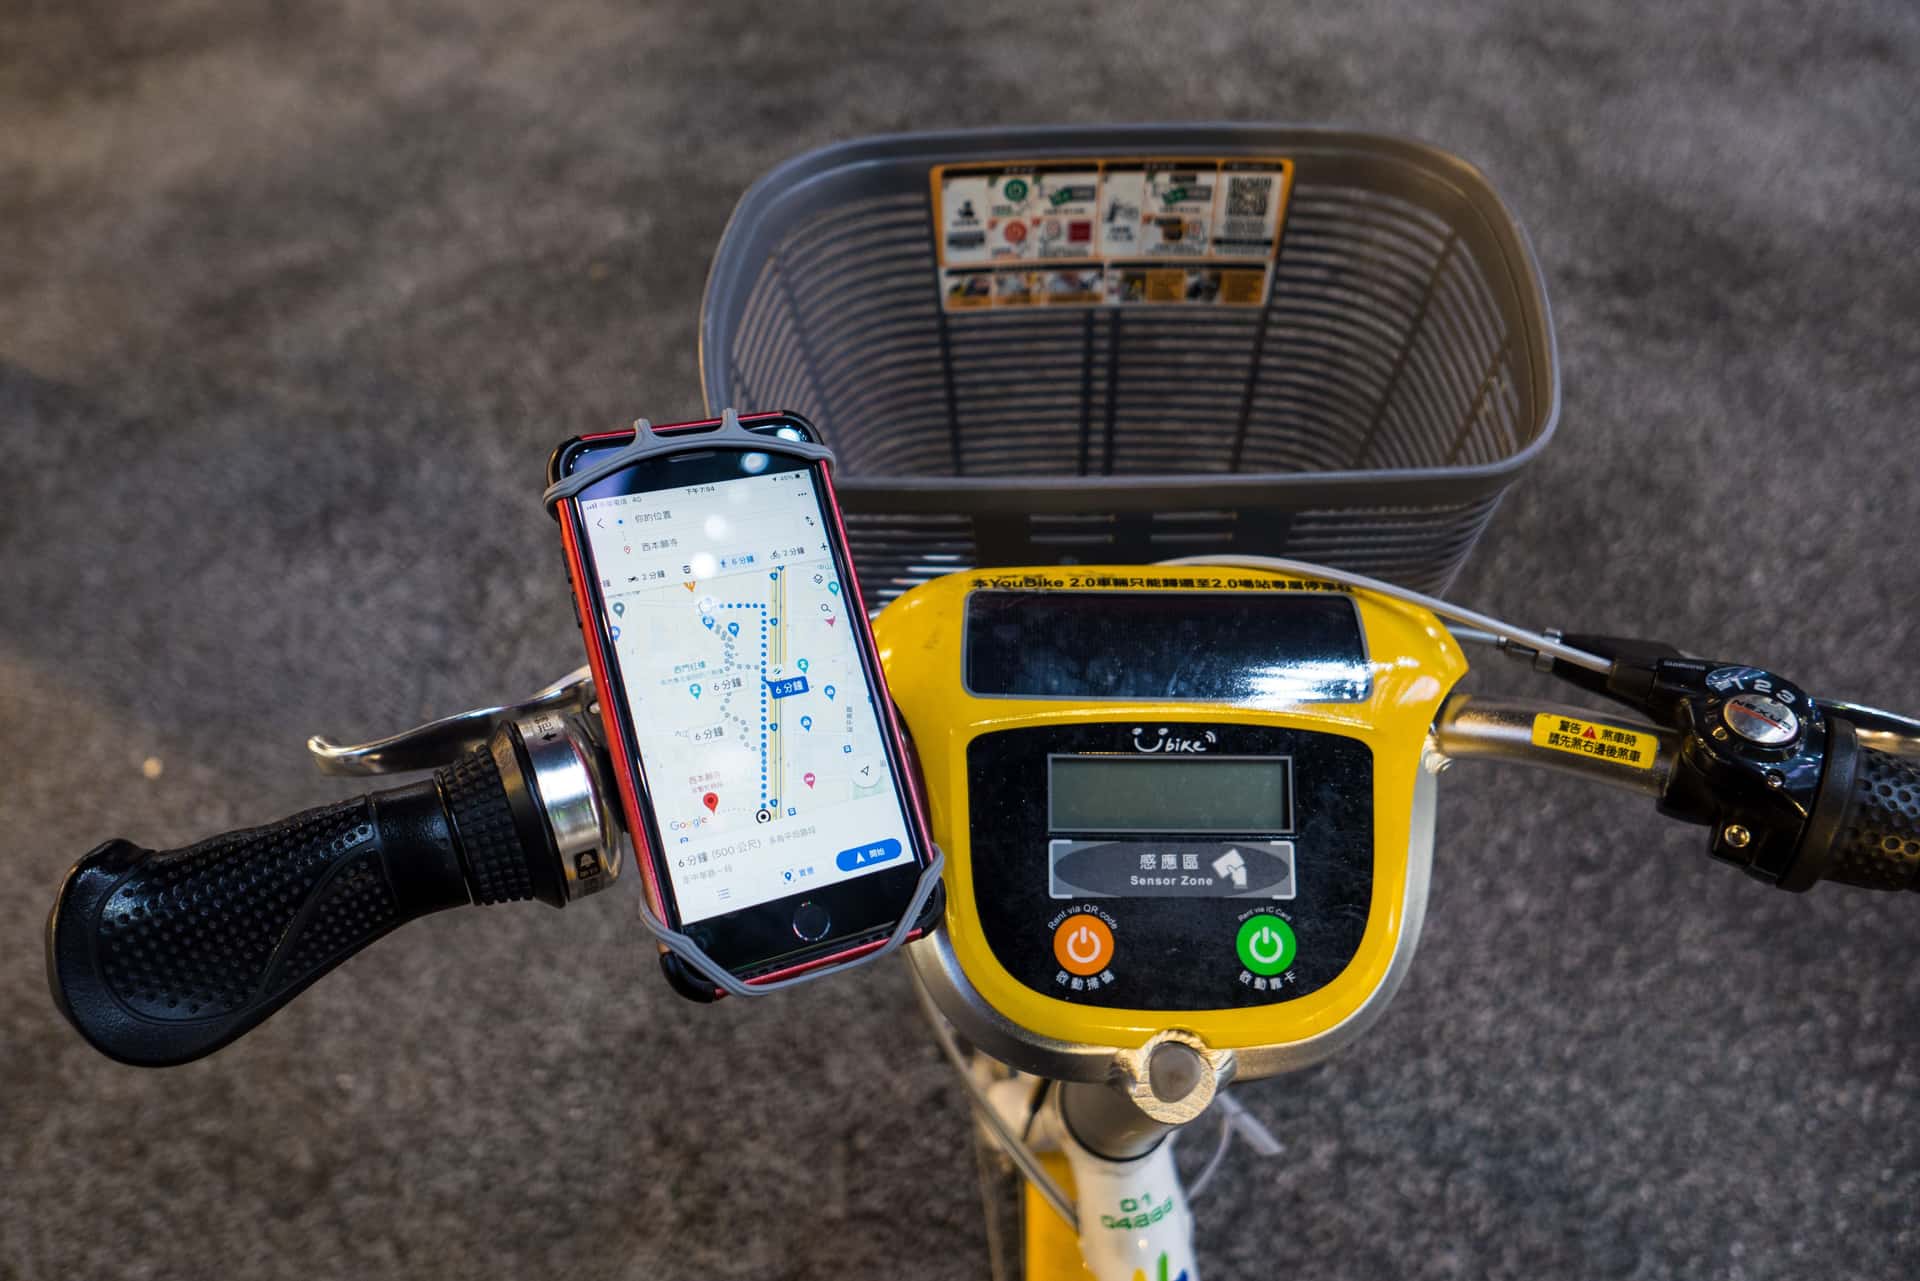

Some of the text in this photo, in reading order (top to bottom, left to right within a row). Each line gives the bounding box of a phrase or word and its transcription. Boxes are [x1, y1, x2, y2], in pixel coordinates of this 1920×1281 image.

[634, 509, 672, 523] 你的位置
[713, 677, 743, 692] 6 分鐘
[775, 681, 805, 695] 6 分鐘
[1753, 679, 1773, 693] 2
[1775, 690, 1796, 704] 3
[1732, 698, 1793, 731] NEXUS
[694, 726, 724, 741] 6 分鐘
[1558, 719, 1638, 747] 警告 煞車時
[1547, 731, 1643, 763] 請先煞右邊後煞車
[669, 814, 708, 831] Google
[678, 858, 686, 869] 6
[686, 852, 709, 867] 分鐘
[711, 845, 735, 860] (500
[869, 846, 886, 859] 開始
[1139, 853, 1200, 870] 感應區
[1130, 875, 1213, 887] Sensor Zone
[1047, 903, 1119, 931] Rent via QR code
